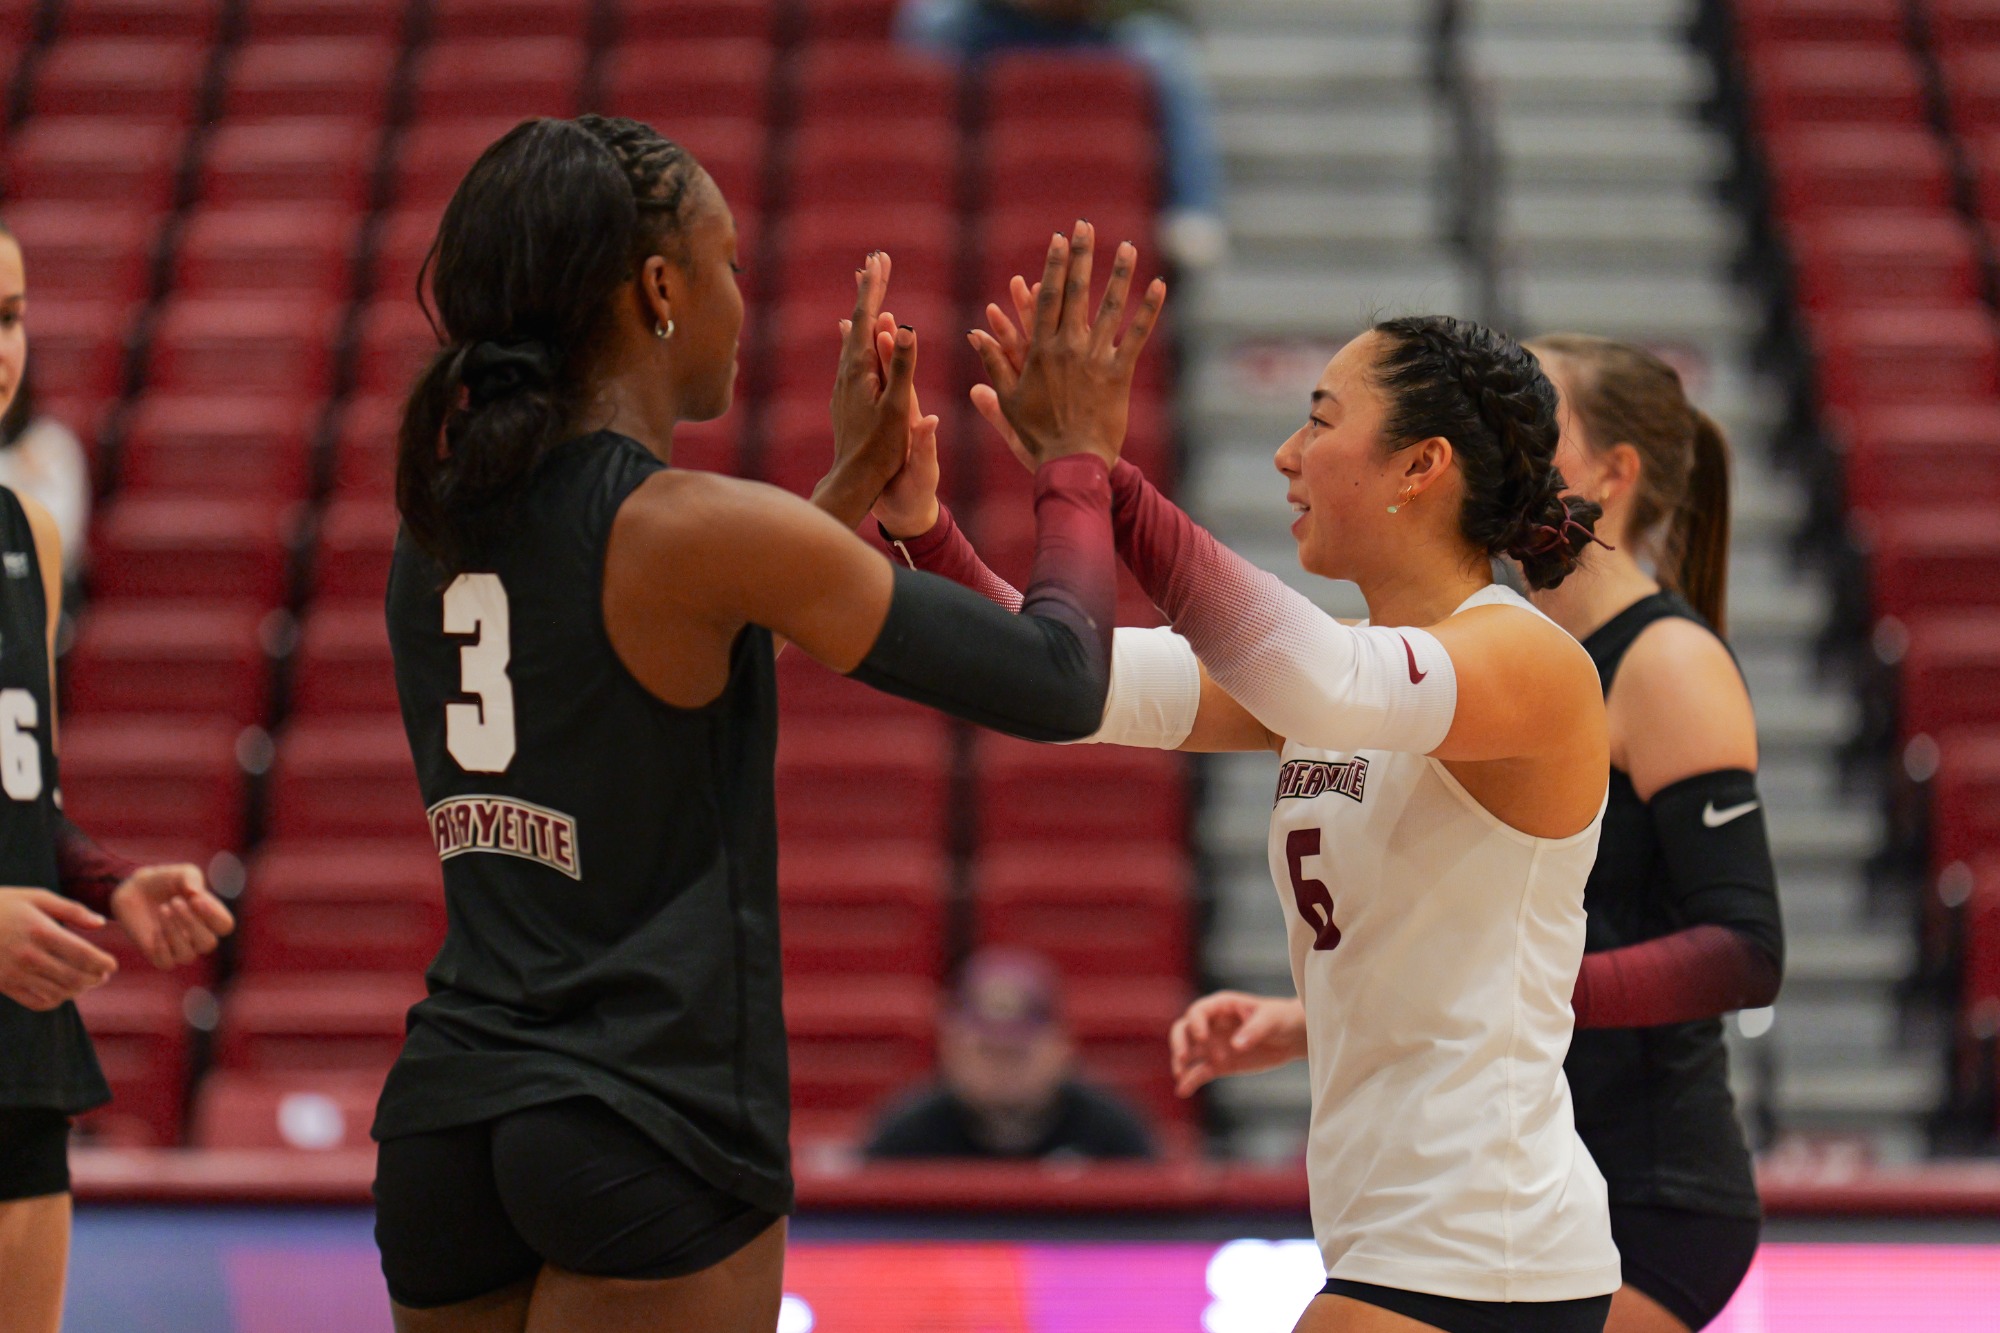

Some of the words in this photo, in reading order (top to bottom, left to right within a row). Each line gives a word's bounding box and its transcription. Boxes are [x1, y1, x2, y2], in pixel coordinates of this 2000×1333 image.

[443, 573, 516, 773] 3
[0, 688, 42, 801] 6
[430, 798, 577, 873] AFAYETTE
[1286, 828, 1342, 951] 6
